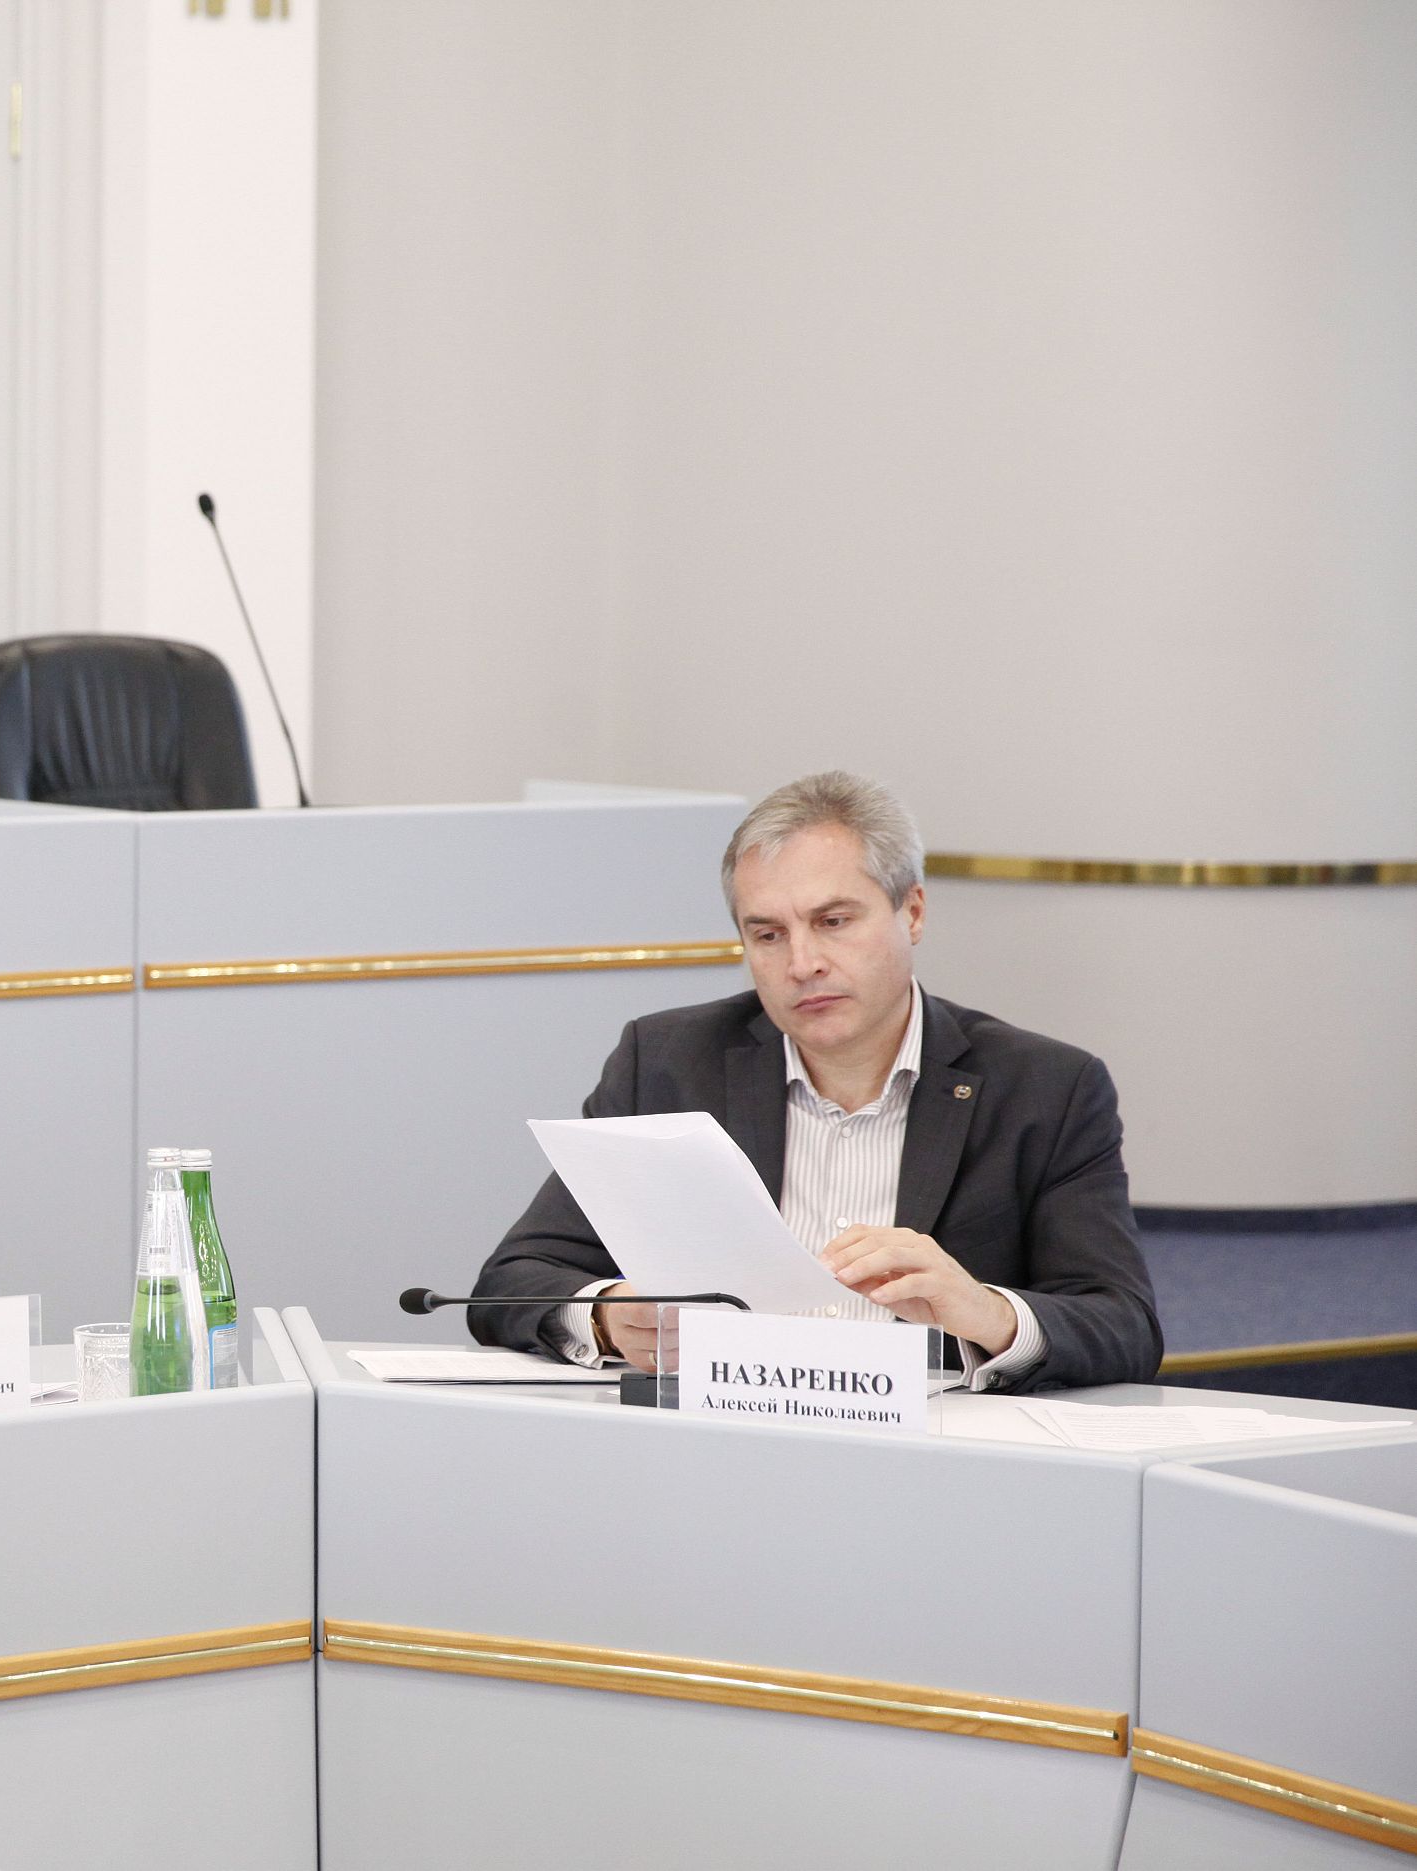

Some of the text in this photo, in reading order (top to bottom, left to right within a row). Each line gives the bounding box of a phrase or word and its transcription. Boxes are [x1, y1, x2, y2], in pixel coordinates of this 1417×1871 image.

[710, 1361, 893, 1396] НАЗАРЕНКО
[701, 1393, 901, 1423] Алексей Николаевич
